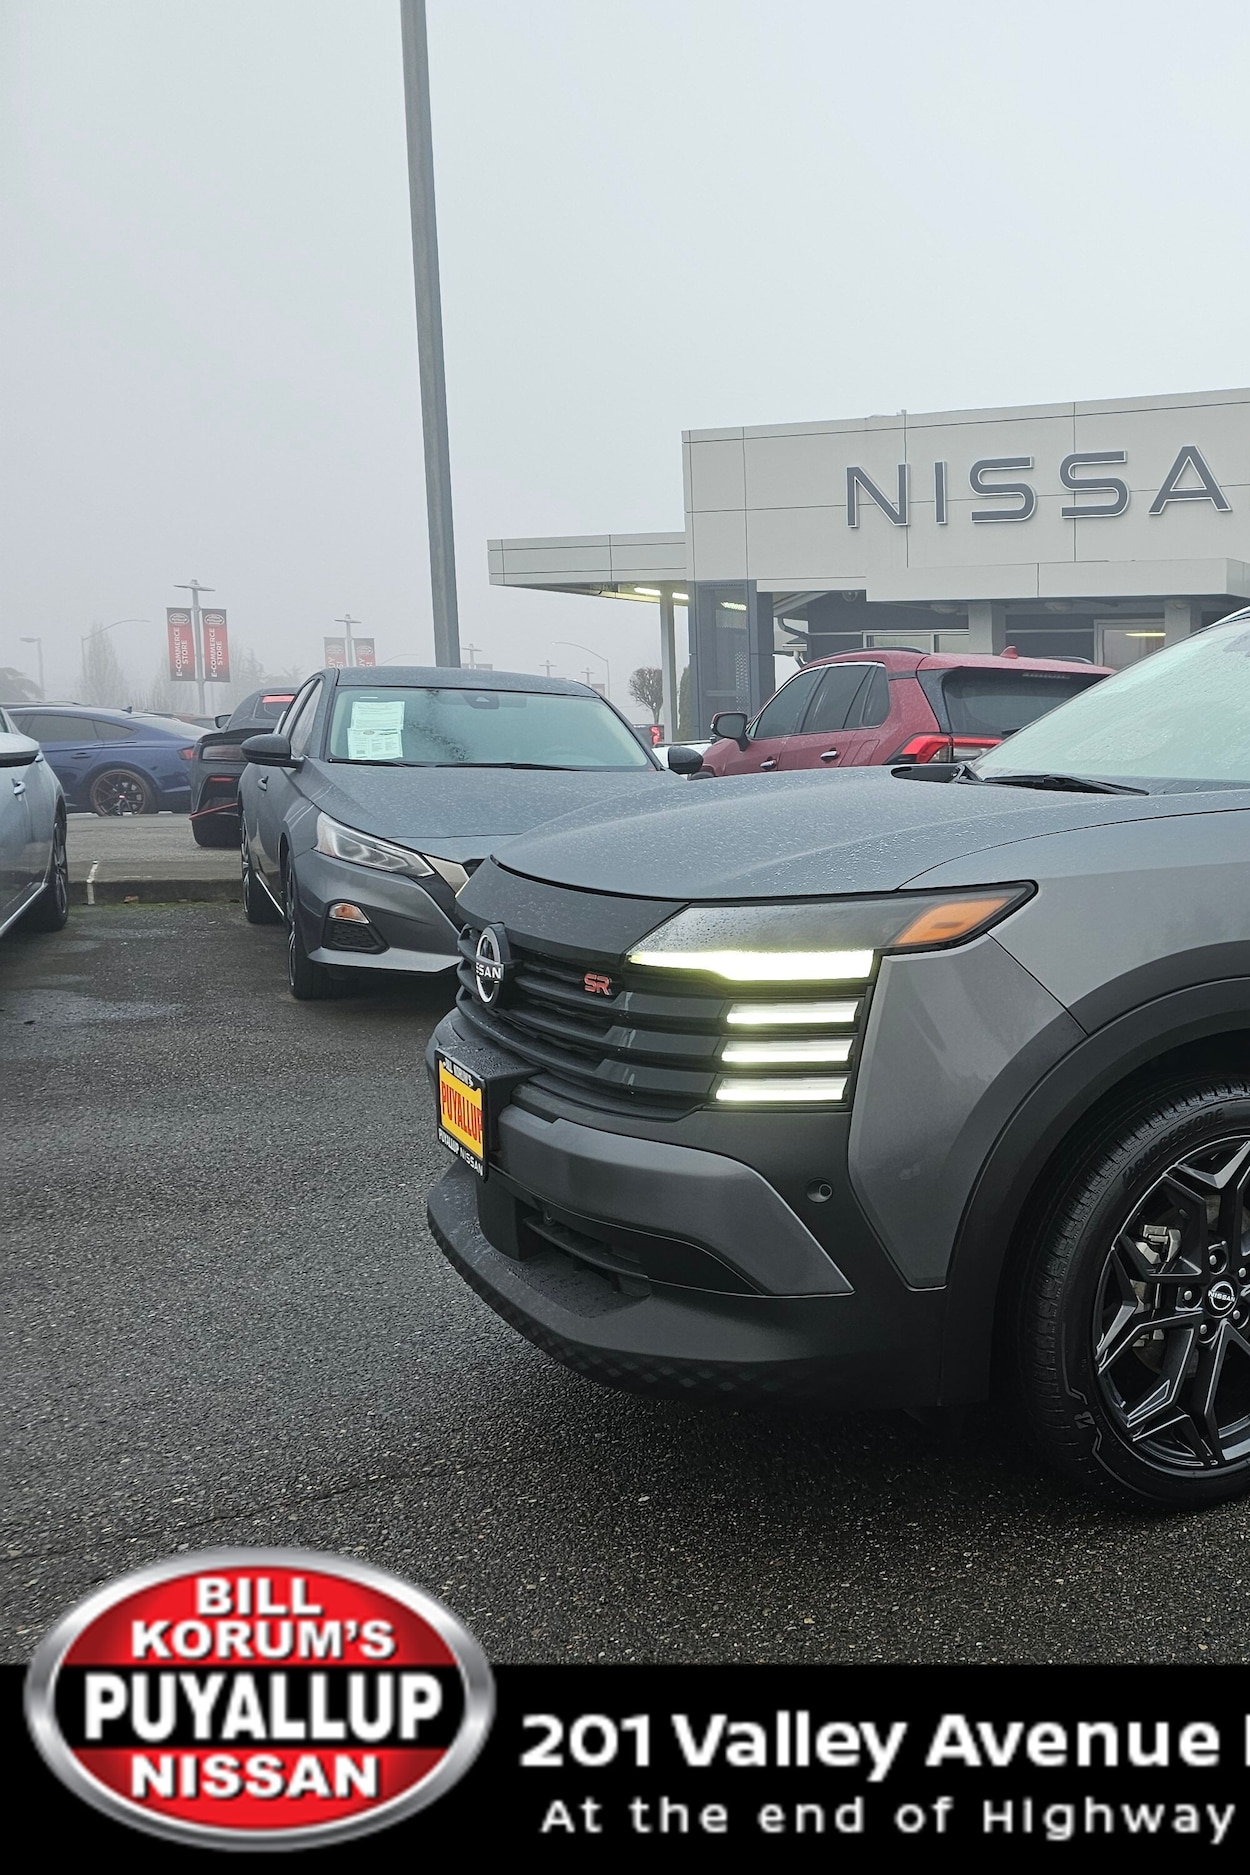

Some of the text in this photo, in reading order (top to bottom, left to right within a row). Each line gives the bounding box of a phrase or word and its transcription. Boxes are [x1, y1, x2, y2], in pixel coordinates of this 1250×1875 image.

[173, 627, 183, 677] E-COMMERCE
[181, 640, 189, 665] STORE
[209, 628, 218, 677] E-COMMERCE
[216, 641, 224, 666] STORE
[584, 973, 611, 996] SR
[441, 1081, 484, 1145] PUYALLUP
[459, 1146, 483, 1176] NISSAN
[1207, 1289, 1236, 1302] NISSAN
